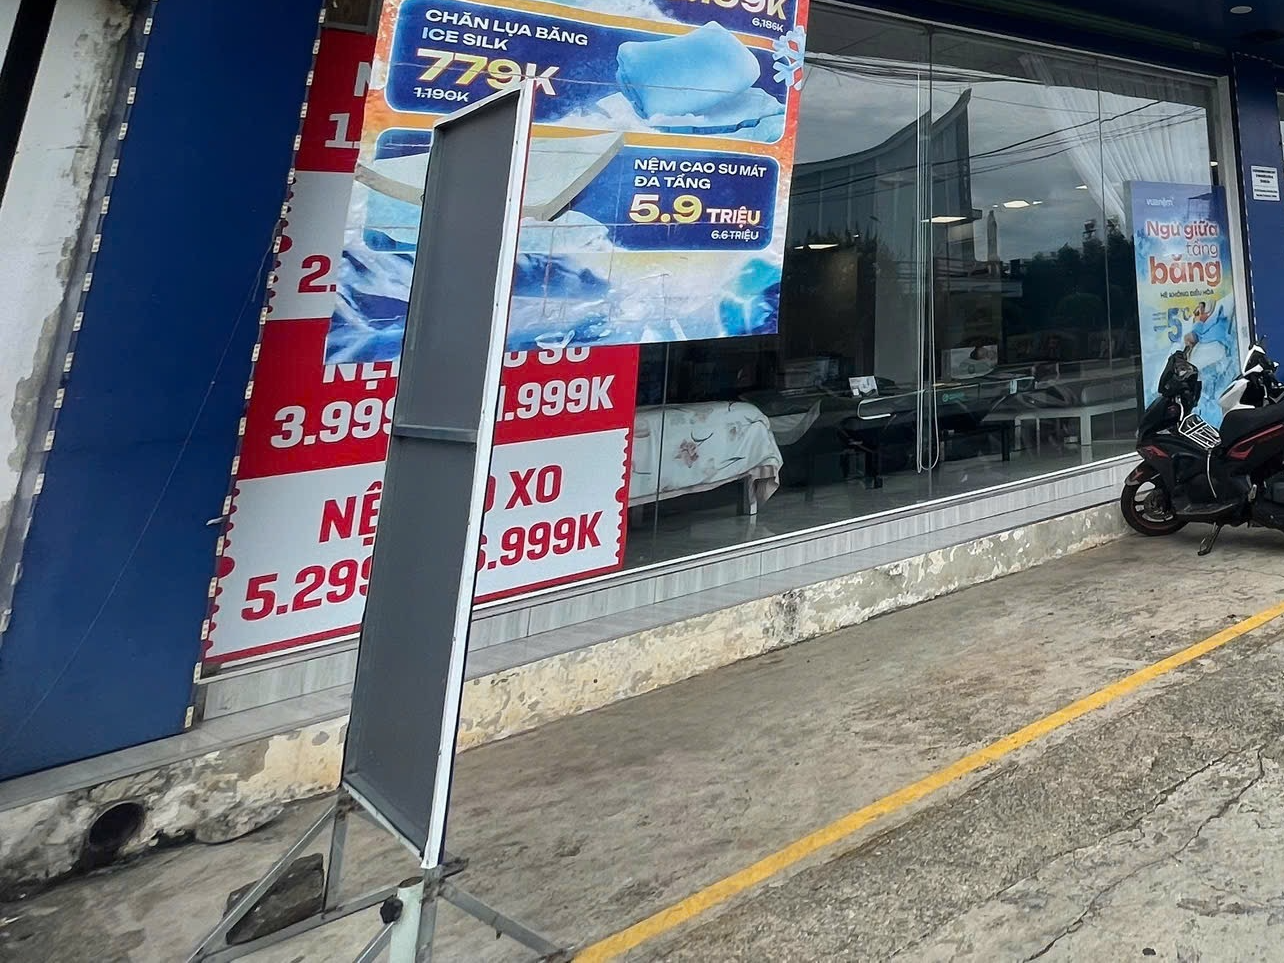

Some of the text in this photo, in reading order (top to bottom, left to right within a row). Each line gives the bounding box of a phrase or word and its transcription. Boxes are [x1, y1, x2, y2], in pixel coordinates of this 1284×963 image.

[422, 26, 509, 51] ICE SILK
[425, 9, 589, 46] CHĂN LỤA BĂNG
[416, 47, 560, 96] 779K
[413, 87, 470, 103] 1.190K
[634, 157, 767, 177] NỆM CAO SU MÁT
[634, 176, 660, 187] ĐA
[629, 193, 760, 228] 5.9 TRIỆU
[711, 229, 759, 242] 6.6 TRIỆU
[1149, 254, 1222, 287] băng
[318, 480, 383, 546] NỆ
[504, 464, 562, 510] XO
